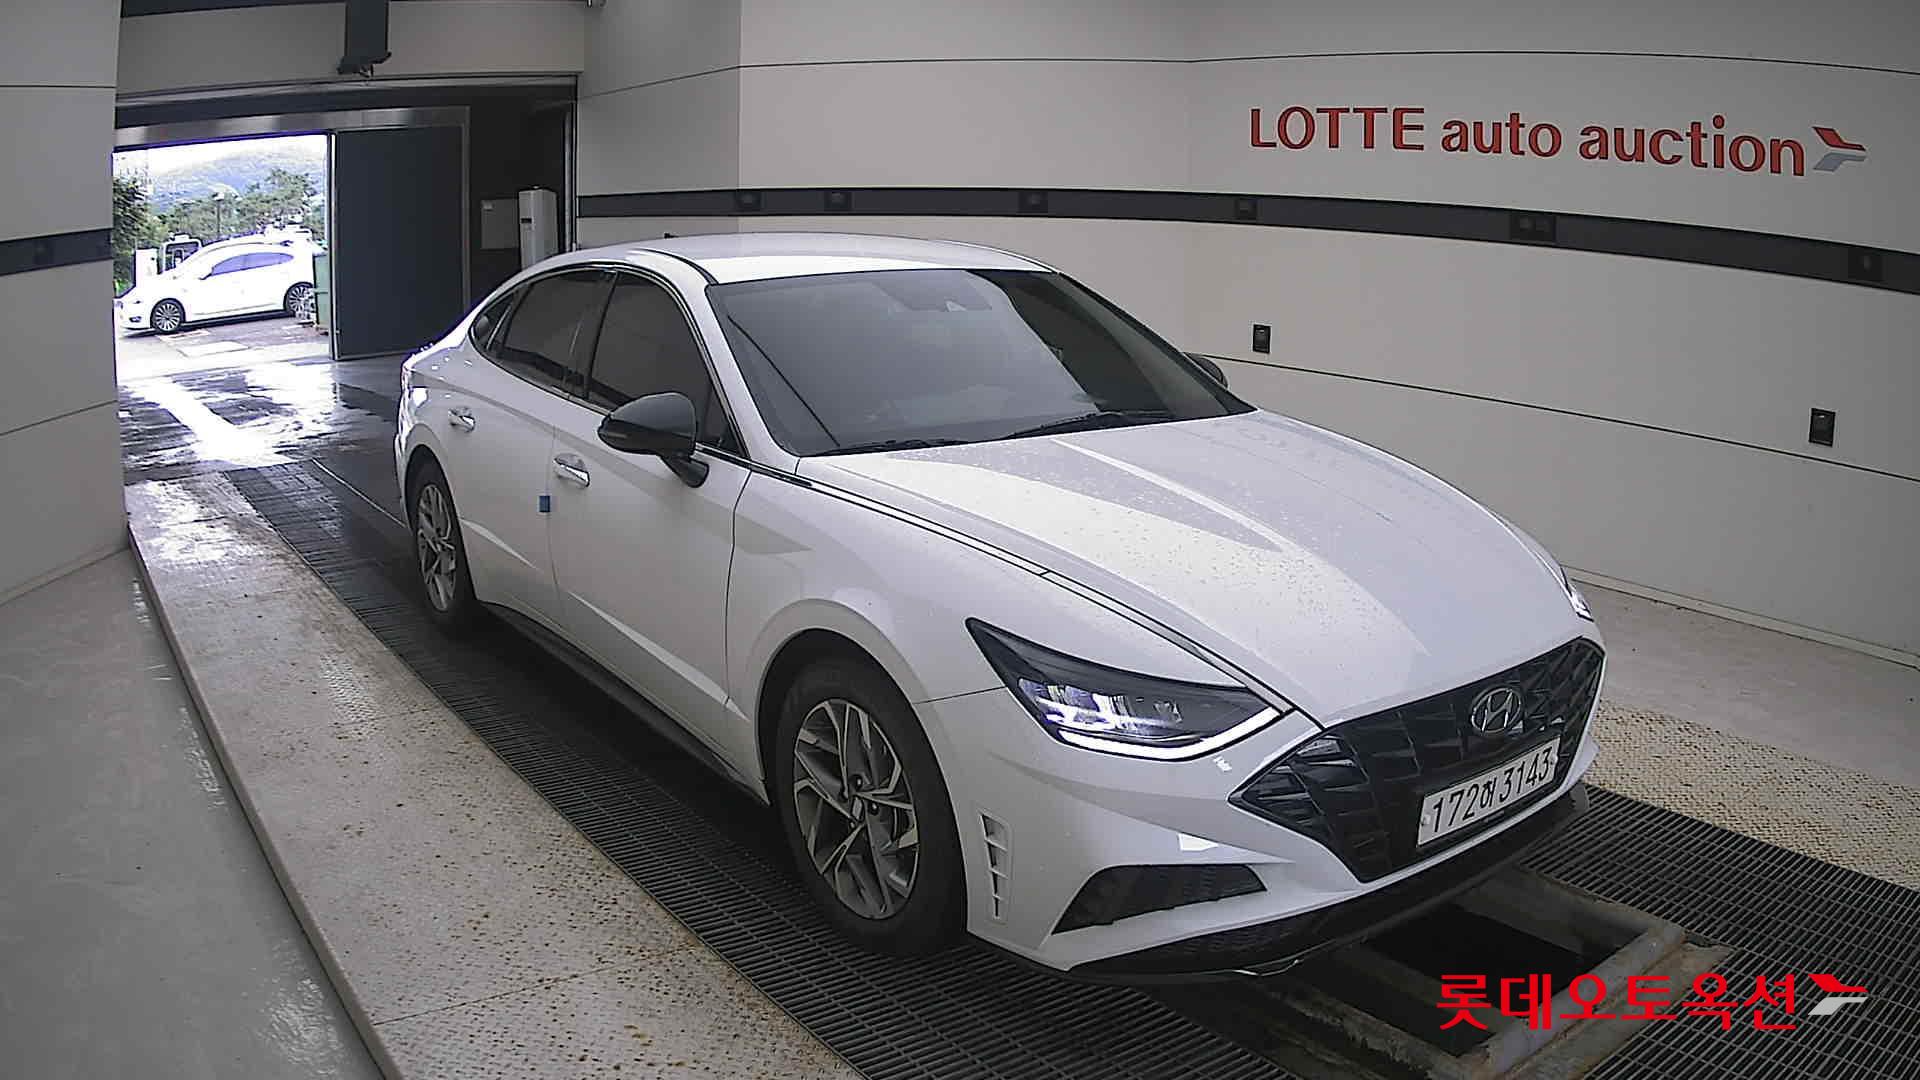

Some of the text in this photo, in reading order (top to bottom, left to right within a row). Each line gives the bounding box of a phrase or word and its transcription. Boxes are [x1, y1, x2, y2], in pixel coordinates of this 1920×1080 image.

[1250, 106, 1805, 175] LOTTE auto auction
[1500, 747, 1553, 803] 3143
